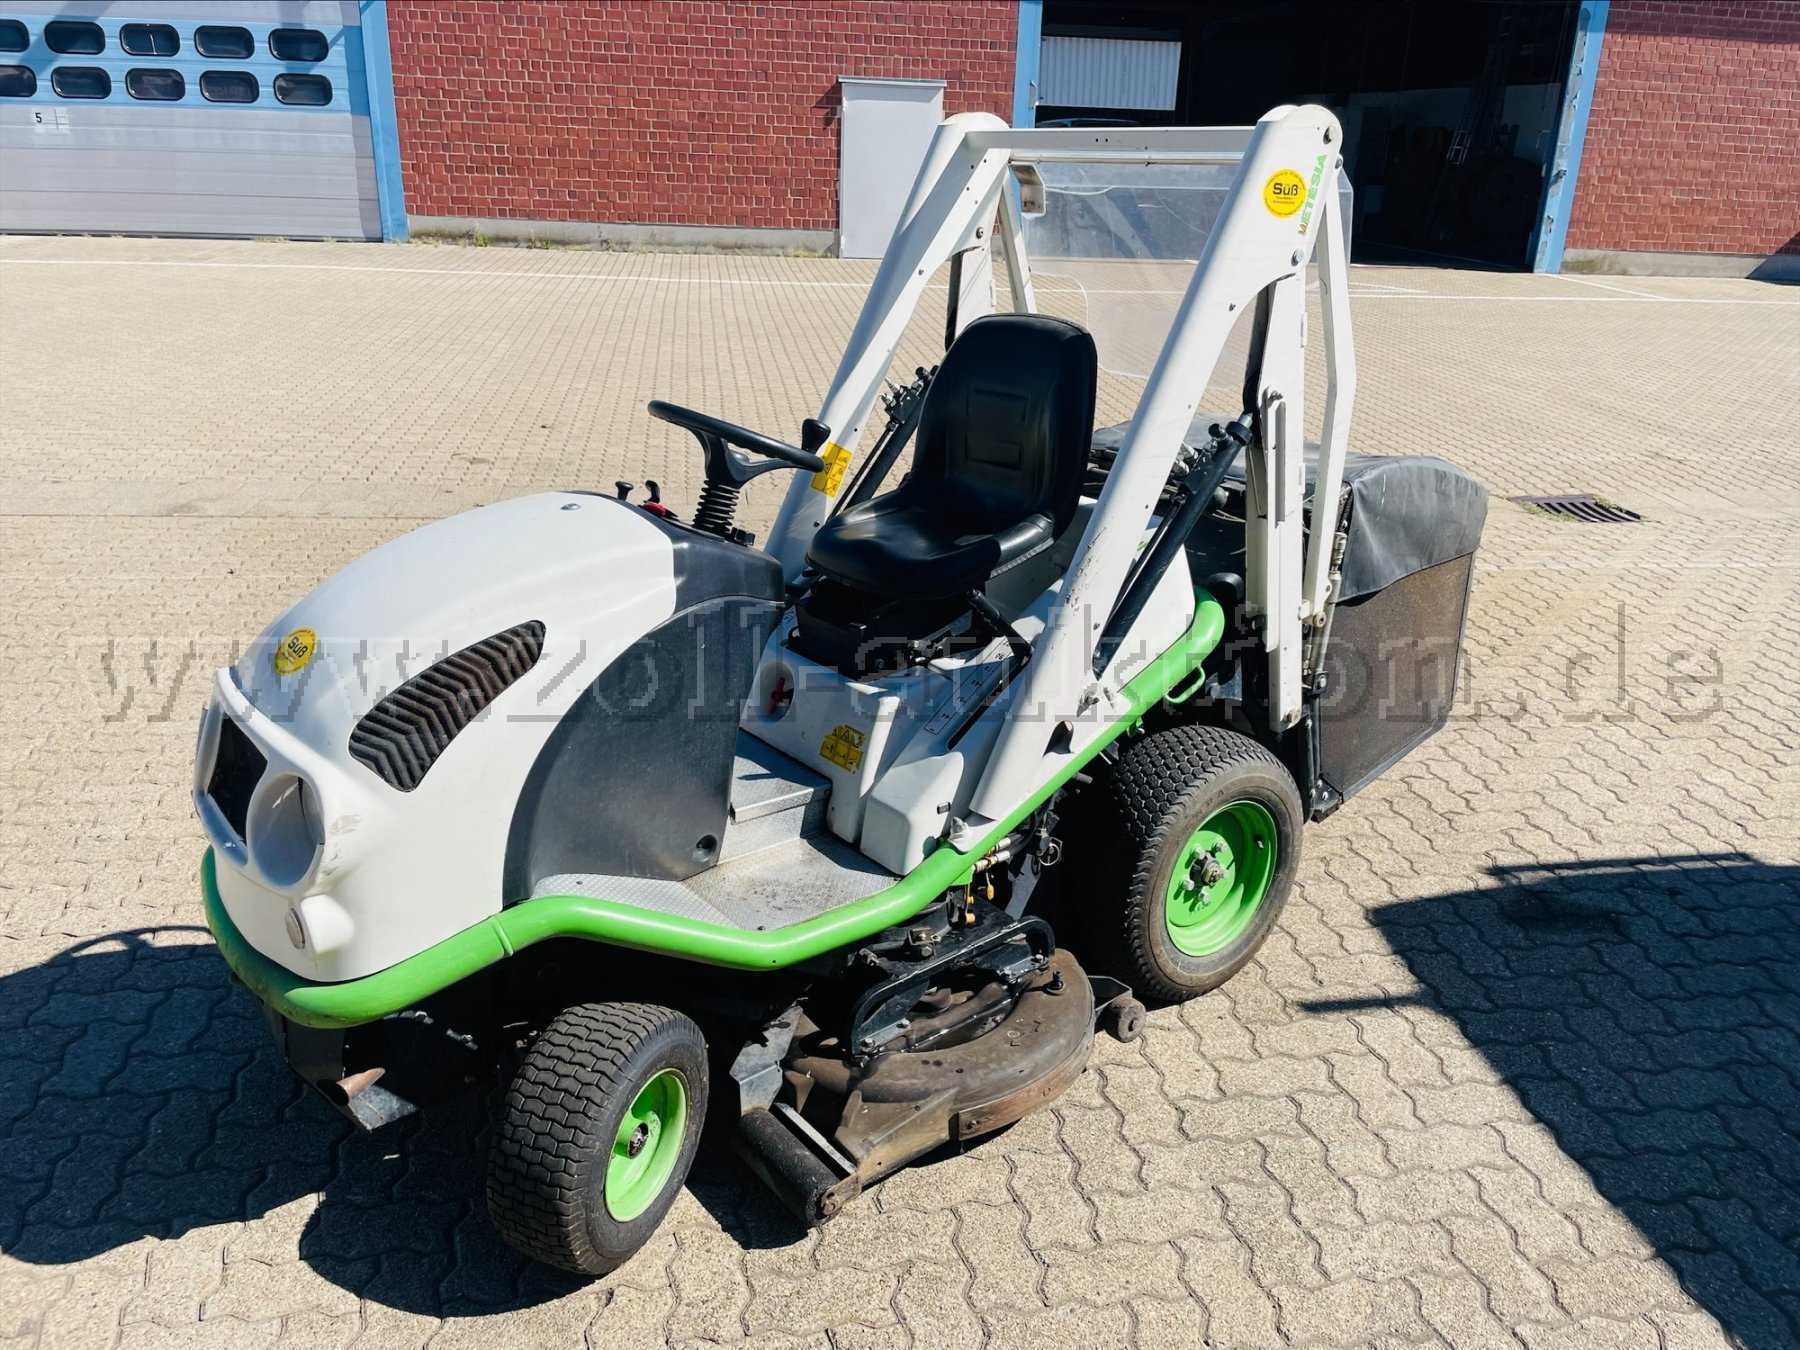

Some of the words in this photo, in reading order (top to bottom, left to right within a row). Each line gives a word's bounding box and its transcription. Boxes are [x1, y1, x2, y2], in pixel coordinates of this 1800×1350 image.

[35, 112, 42, 123] 5
[1272, 182, 1299, 197] Süß
[287, 636, 308, 658] Süß
